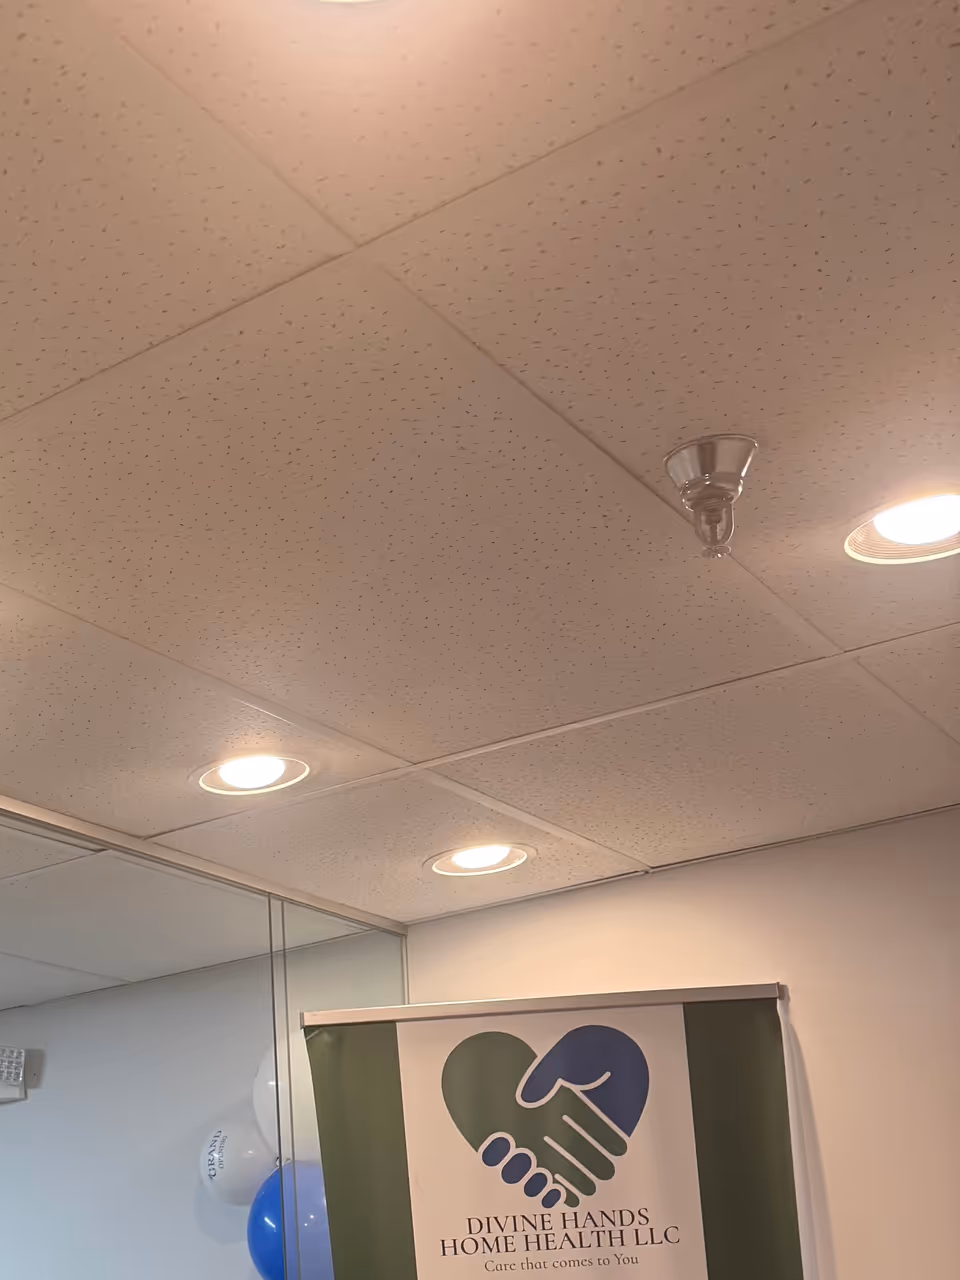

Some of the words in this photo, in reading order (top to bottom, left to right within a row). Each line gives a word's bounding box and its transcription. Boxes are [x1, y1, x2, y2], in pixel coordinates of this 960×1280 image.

[208, 1130, 222, 1179] GRAND
[466, 1213, 553, 1235] DIVINE
[561, 1208, 650, 1230] HANDS
[440, 1235, 516, 1257] HOME
[524, 1229, 625, 1252] HEALTH
[634, 1226, 680, 1246] LLC
[485, 1260, 516, 1273] Care
[520, 1257, 548, 1270] that
[552, 1256, 593, 1269] comes
[597, 1255, 610, 1266] to
[613, 1253, 639, 1265] You
